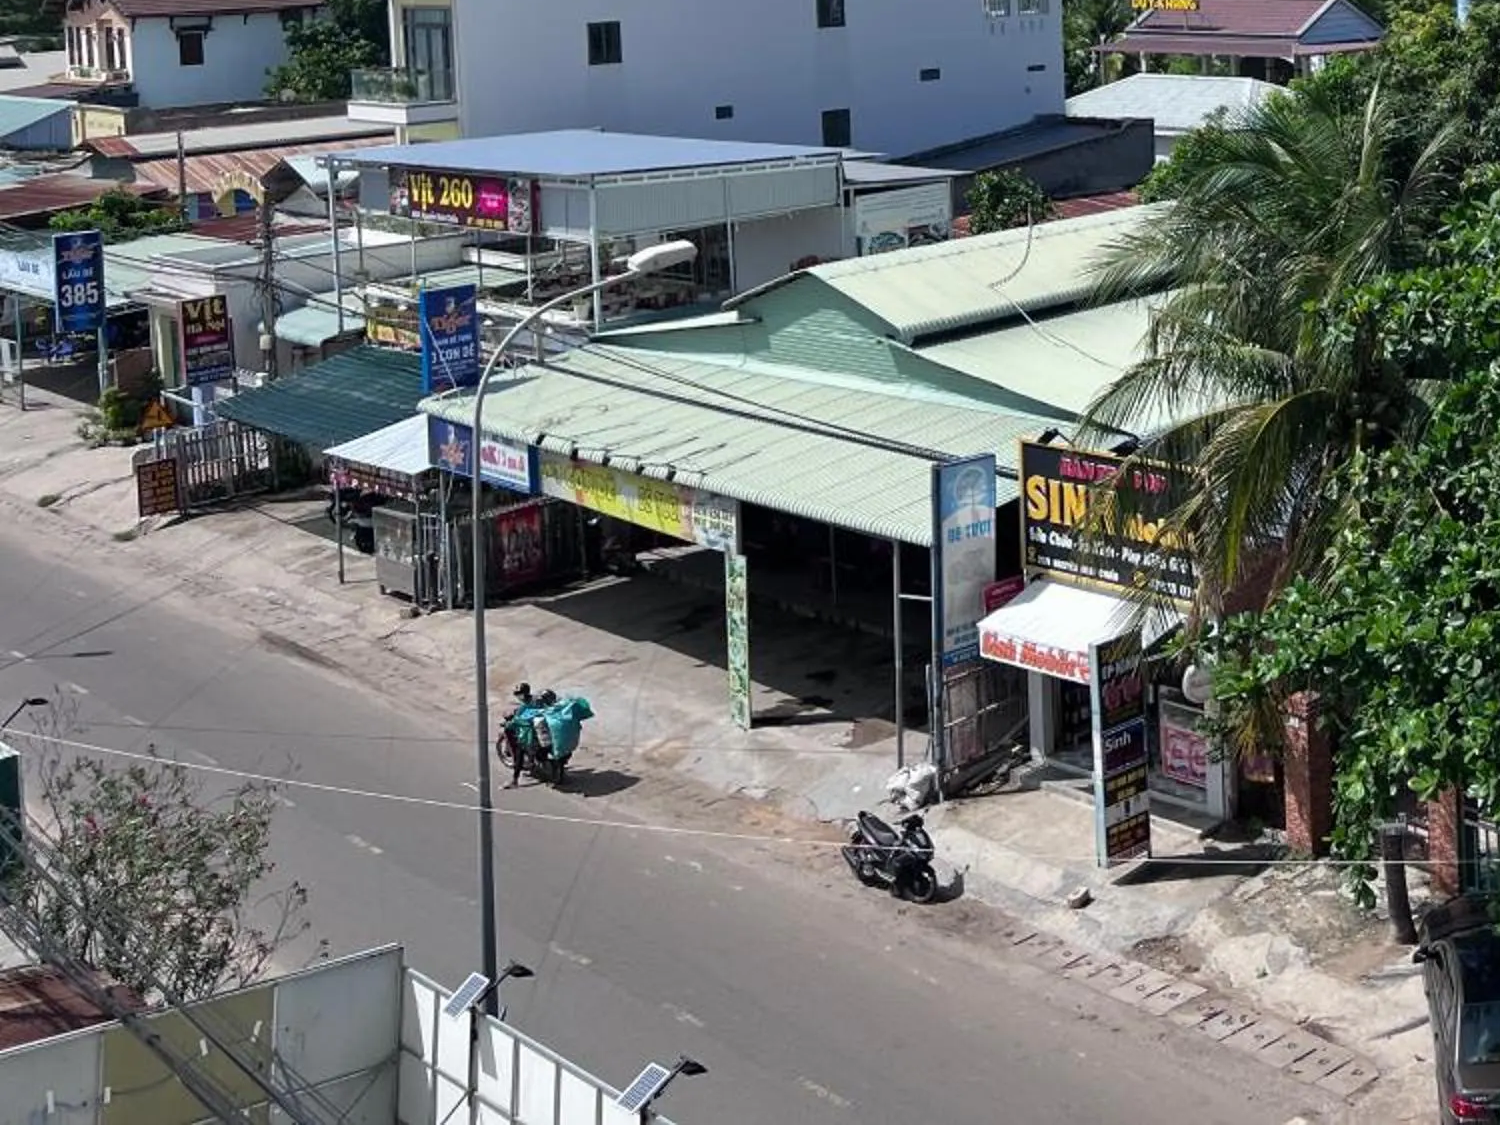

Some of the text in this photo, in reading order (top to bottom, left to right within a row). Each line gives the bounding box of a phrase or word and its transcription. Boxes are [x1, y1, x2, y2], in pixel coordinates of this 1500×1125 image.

[439, 177, 473, 209] 260
[61, 282, 99, 307] 385
[1104, 730, 1132, 753] Sinh
